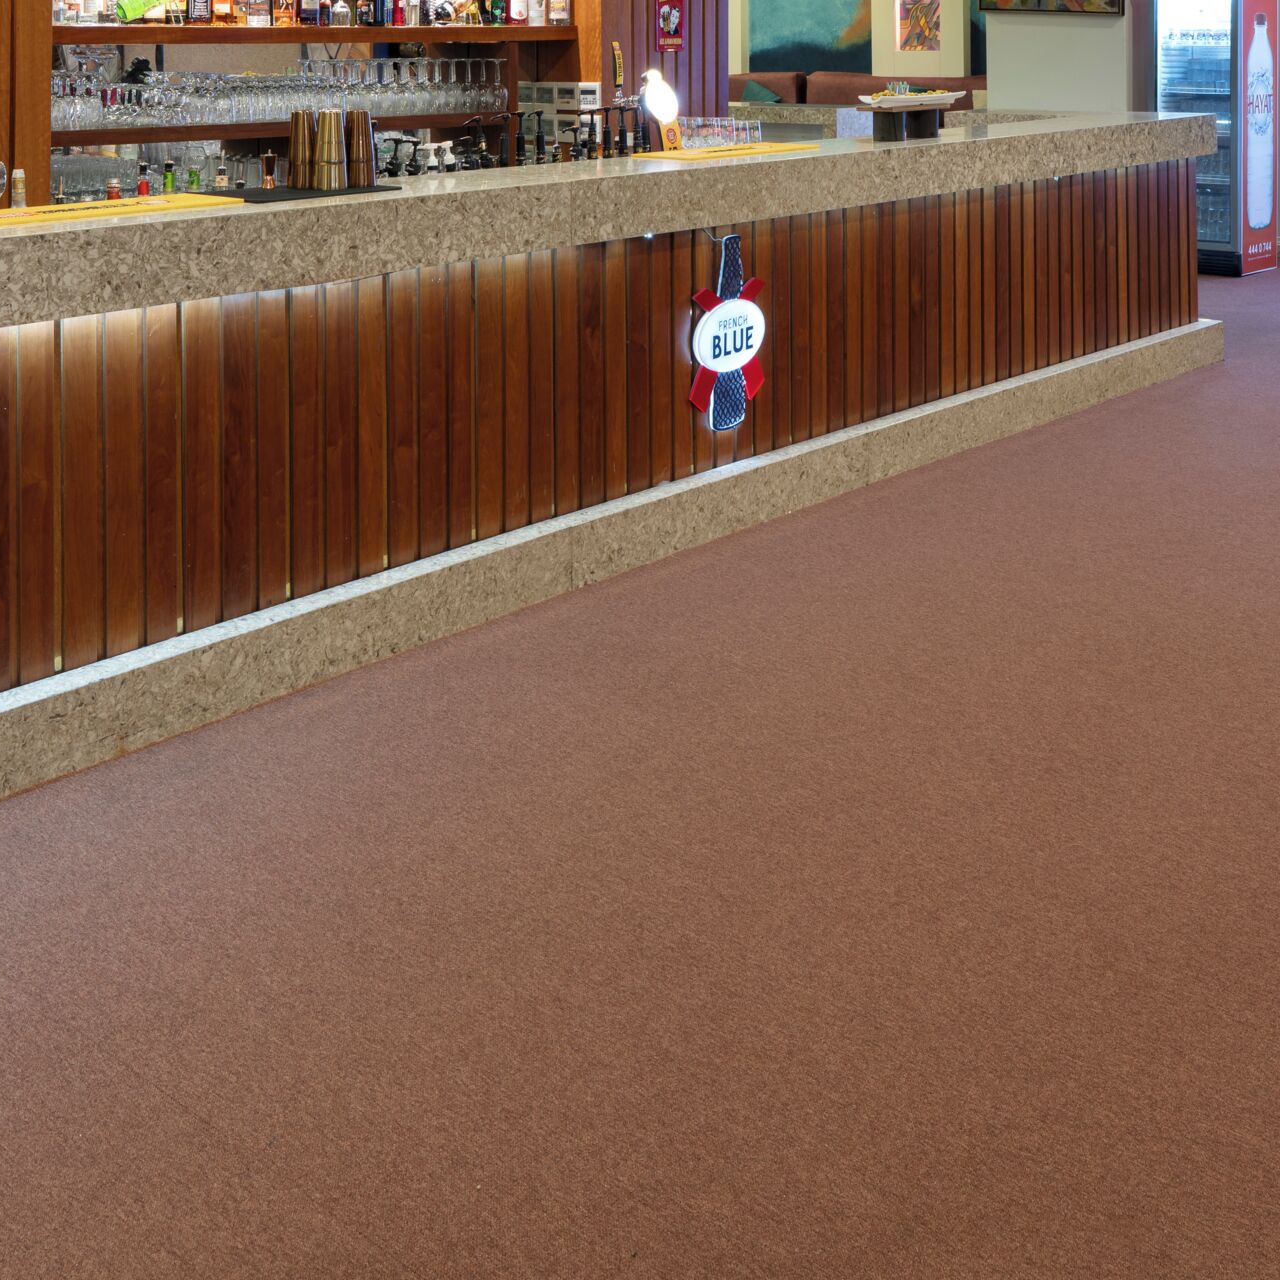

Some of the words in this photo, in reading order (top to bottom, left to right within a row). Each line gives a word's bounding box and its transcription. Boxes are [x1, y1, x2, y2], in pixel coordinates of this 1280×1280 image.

[1248, 93, 1273, 114] HAYAT
[1248, 244, 1258, 255] 444
[719, 314, 748, 331] FRENCH
[713, 326, 754, 360] BLUE
